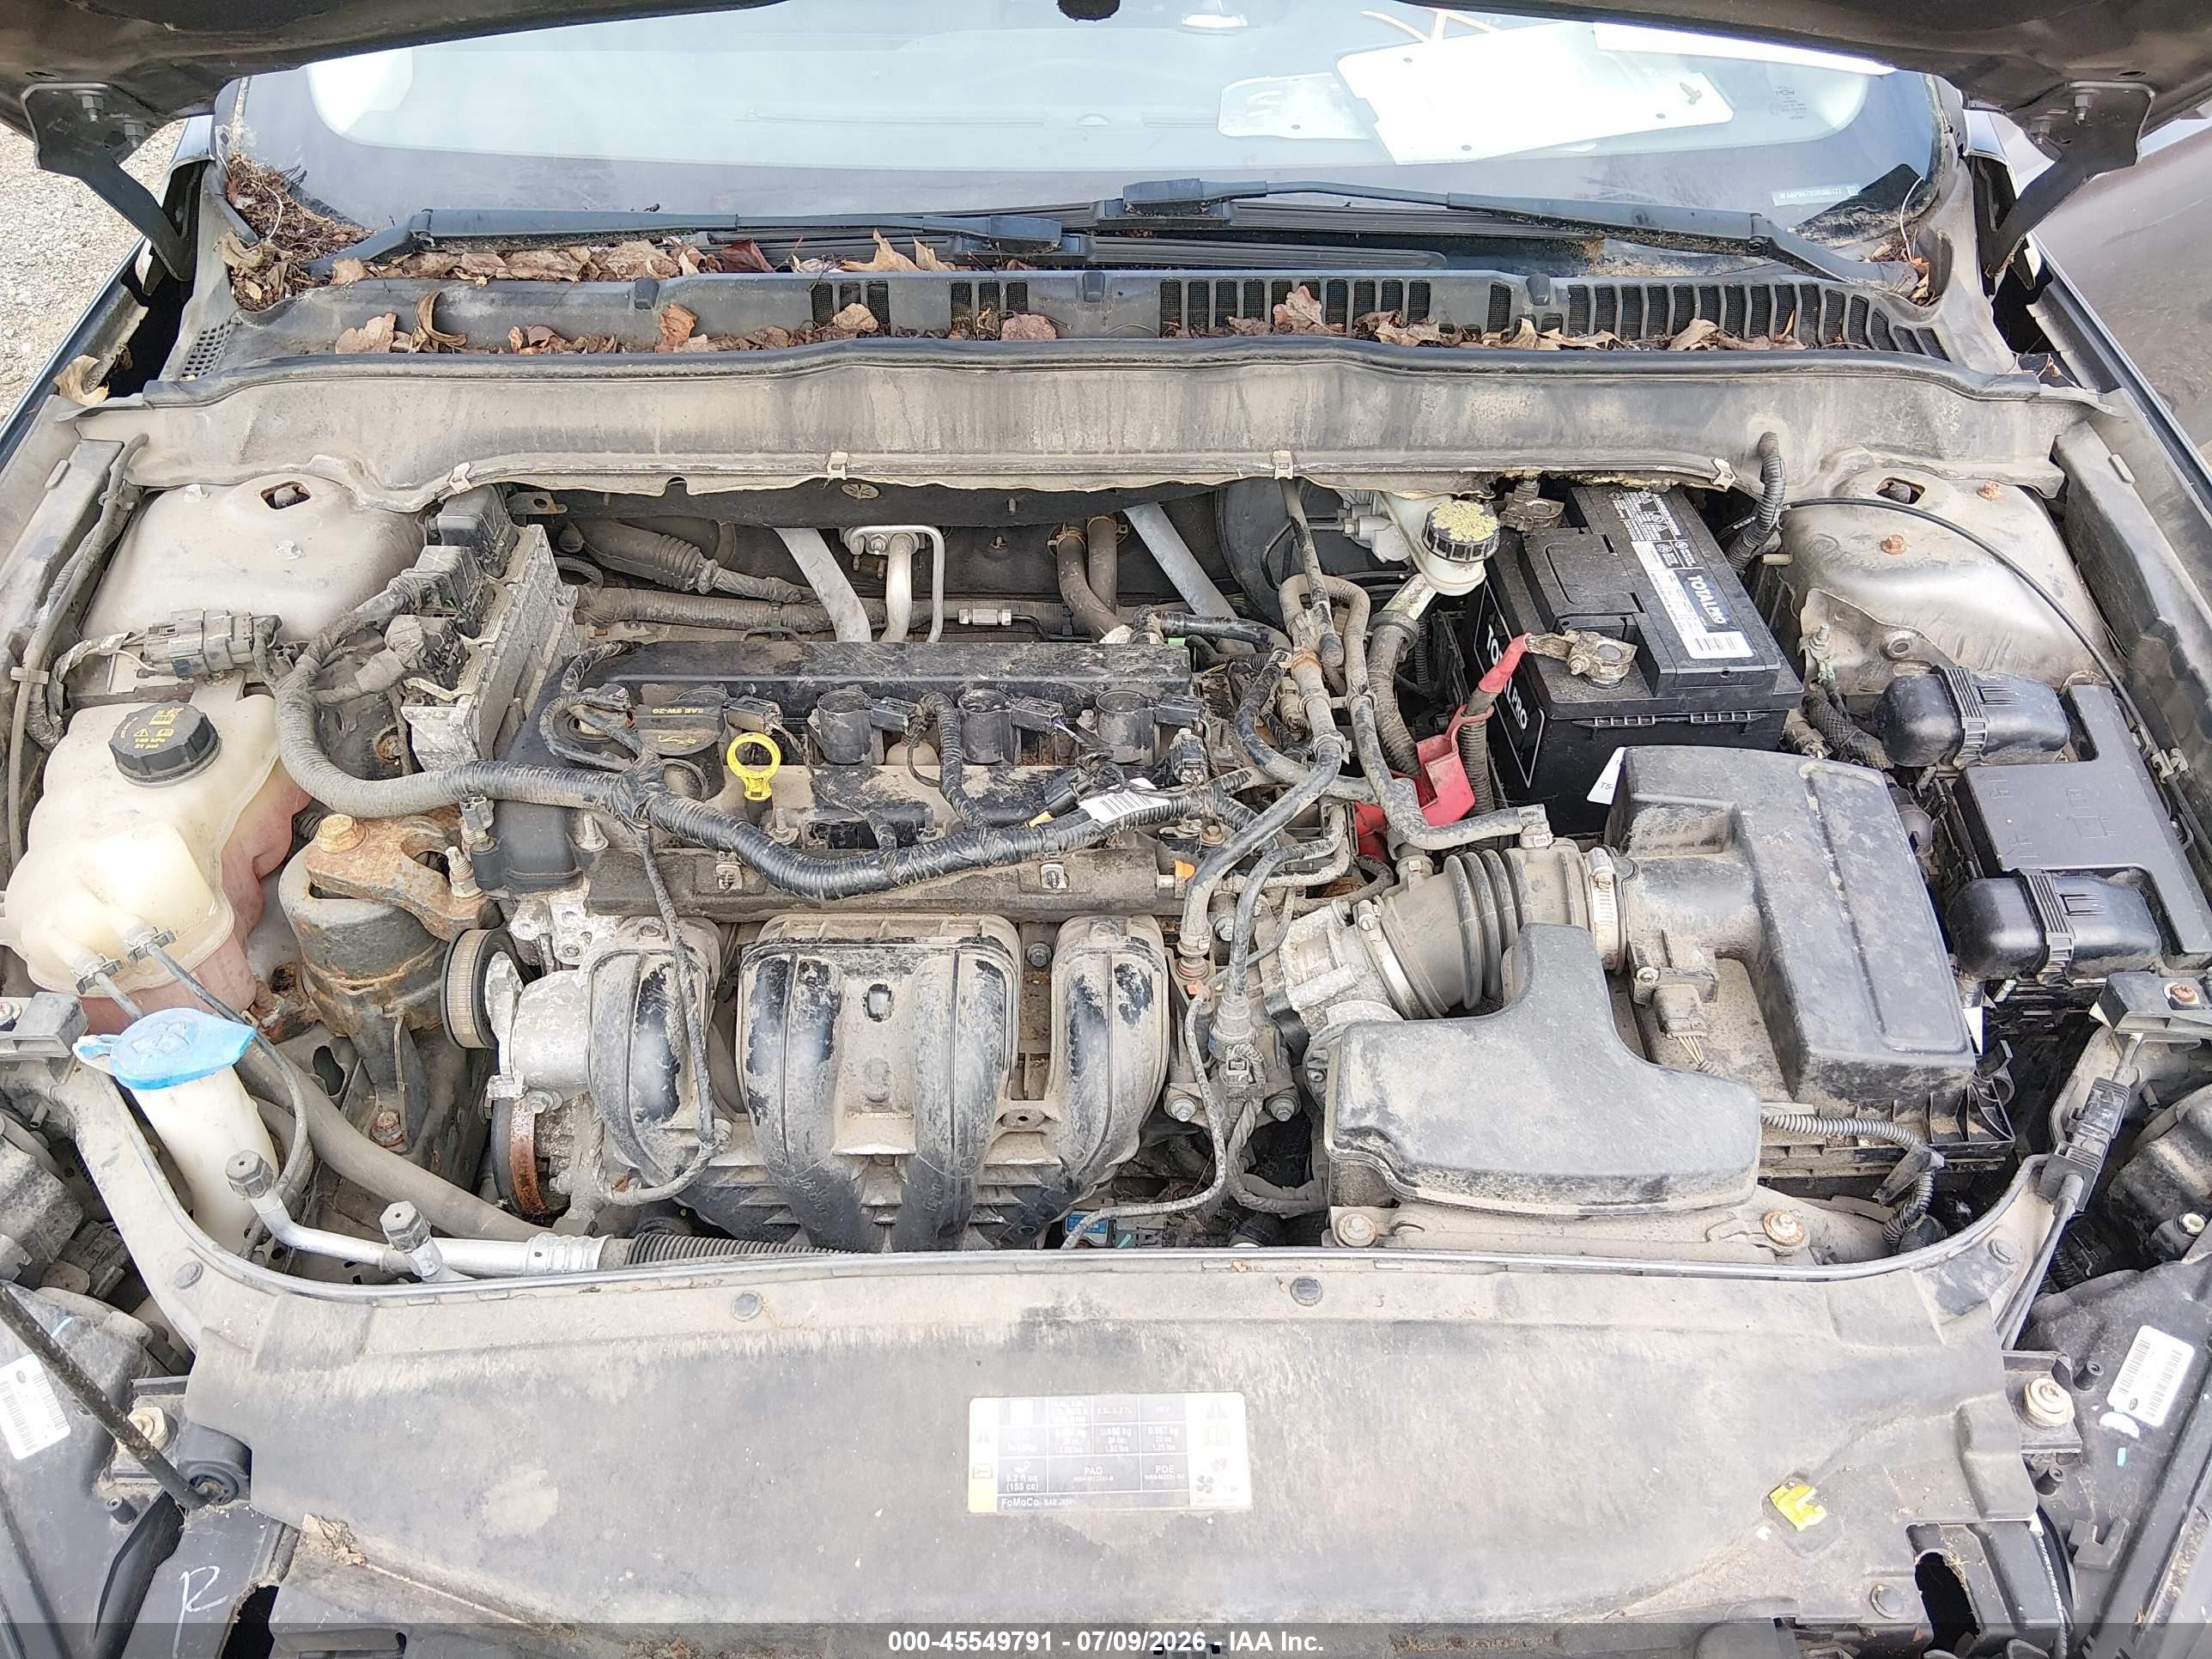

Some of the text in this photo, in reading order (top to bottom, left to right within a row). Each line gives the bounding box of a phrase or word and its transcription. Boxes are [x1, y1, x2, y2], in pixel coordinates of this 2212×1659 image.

[1686, 574, 1728, 625] TOTALPRO
[1486, 623, 1528, 730] TOLPRO
[1121, 1426, 1132, 1437] kg
[1084, 1466, 1103, 1475] PAG
[1155, 1464, 1176, 1474] POE
[1006, 1482, 1039, 1492] (155 cc)
[1001, 1498, 1040, 1508] FoMoCo
[173, 1565, 228, 1658] R
